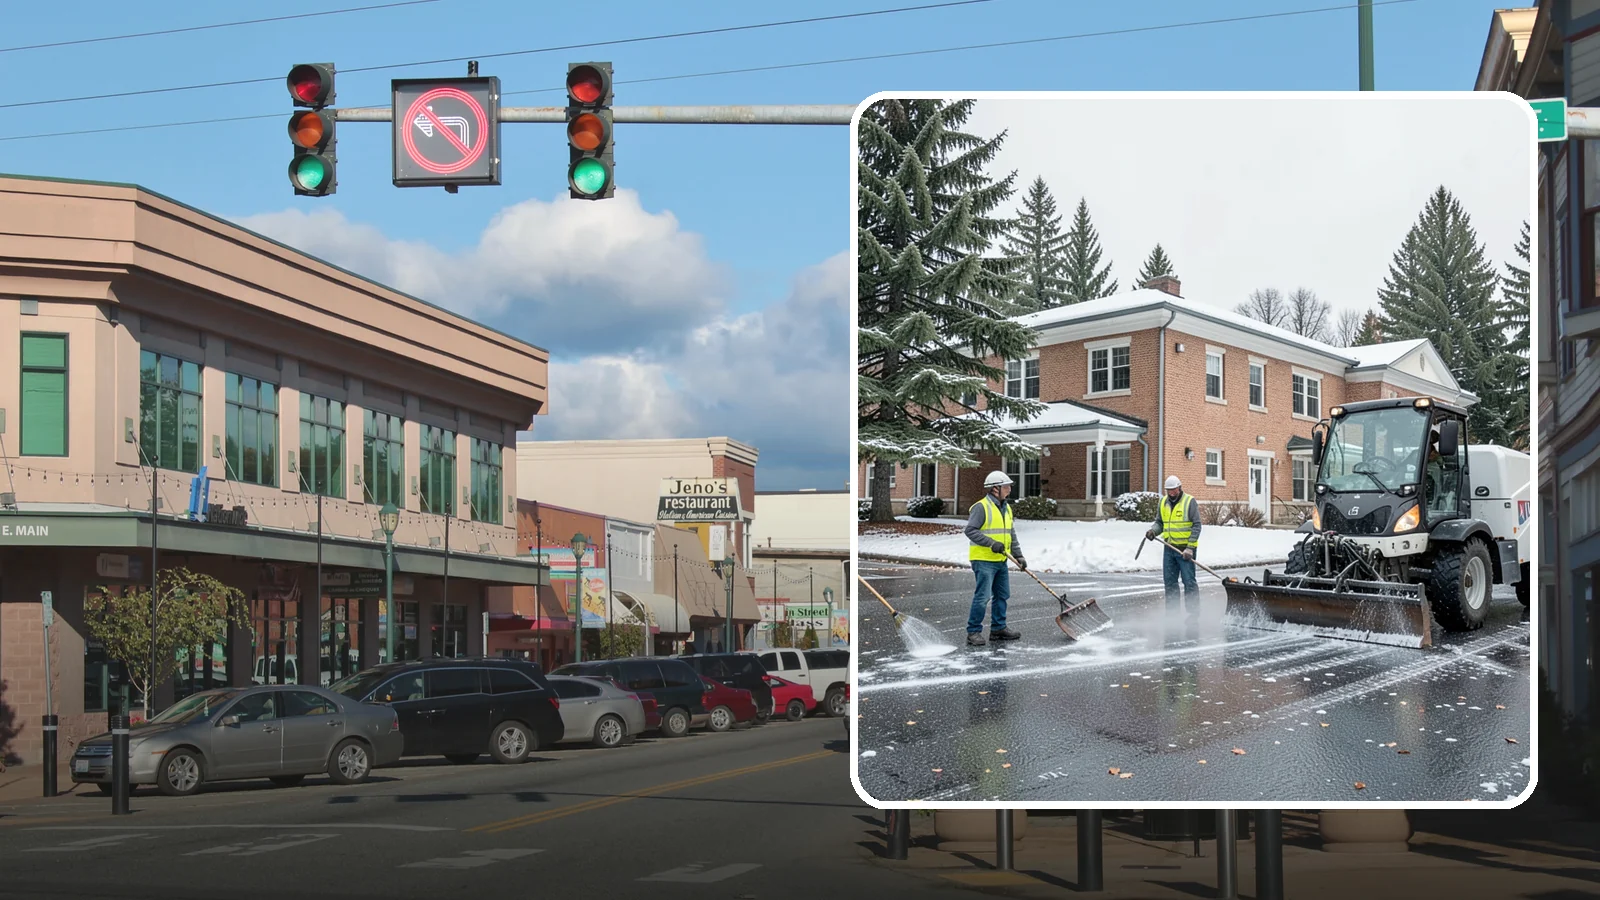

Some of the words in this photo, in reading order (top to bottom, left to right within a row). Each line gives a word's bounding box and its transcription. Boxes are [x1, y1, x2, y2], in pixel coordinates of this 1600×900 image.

[669, 480, 727, 495] Jeno's
[665, 496, 731, 509] restaurant
[686, 509, 714, 519] American
[715, 509, 738, 519] Cuisine
[2, 525, 13, 536] E.
[15, 525, 49, 536] MAIN
[797, 607, 828, 617] Street
